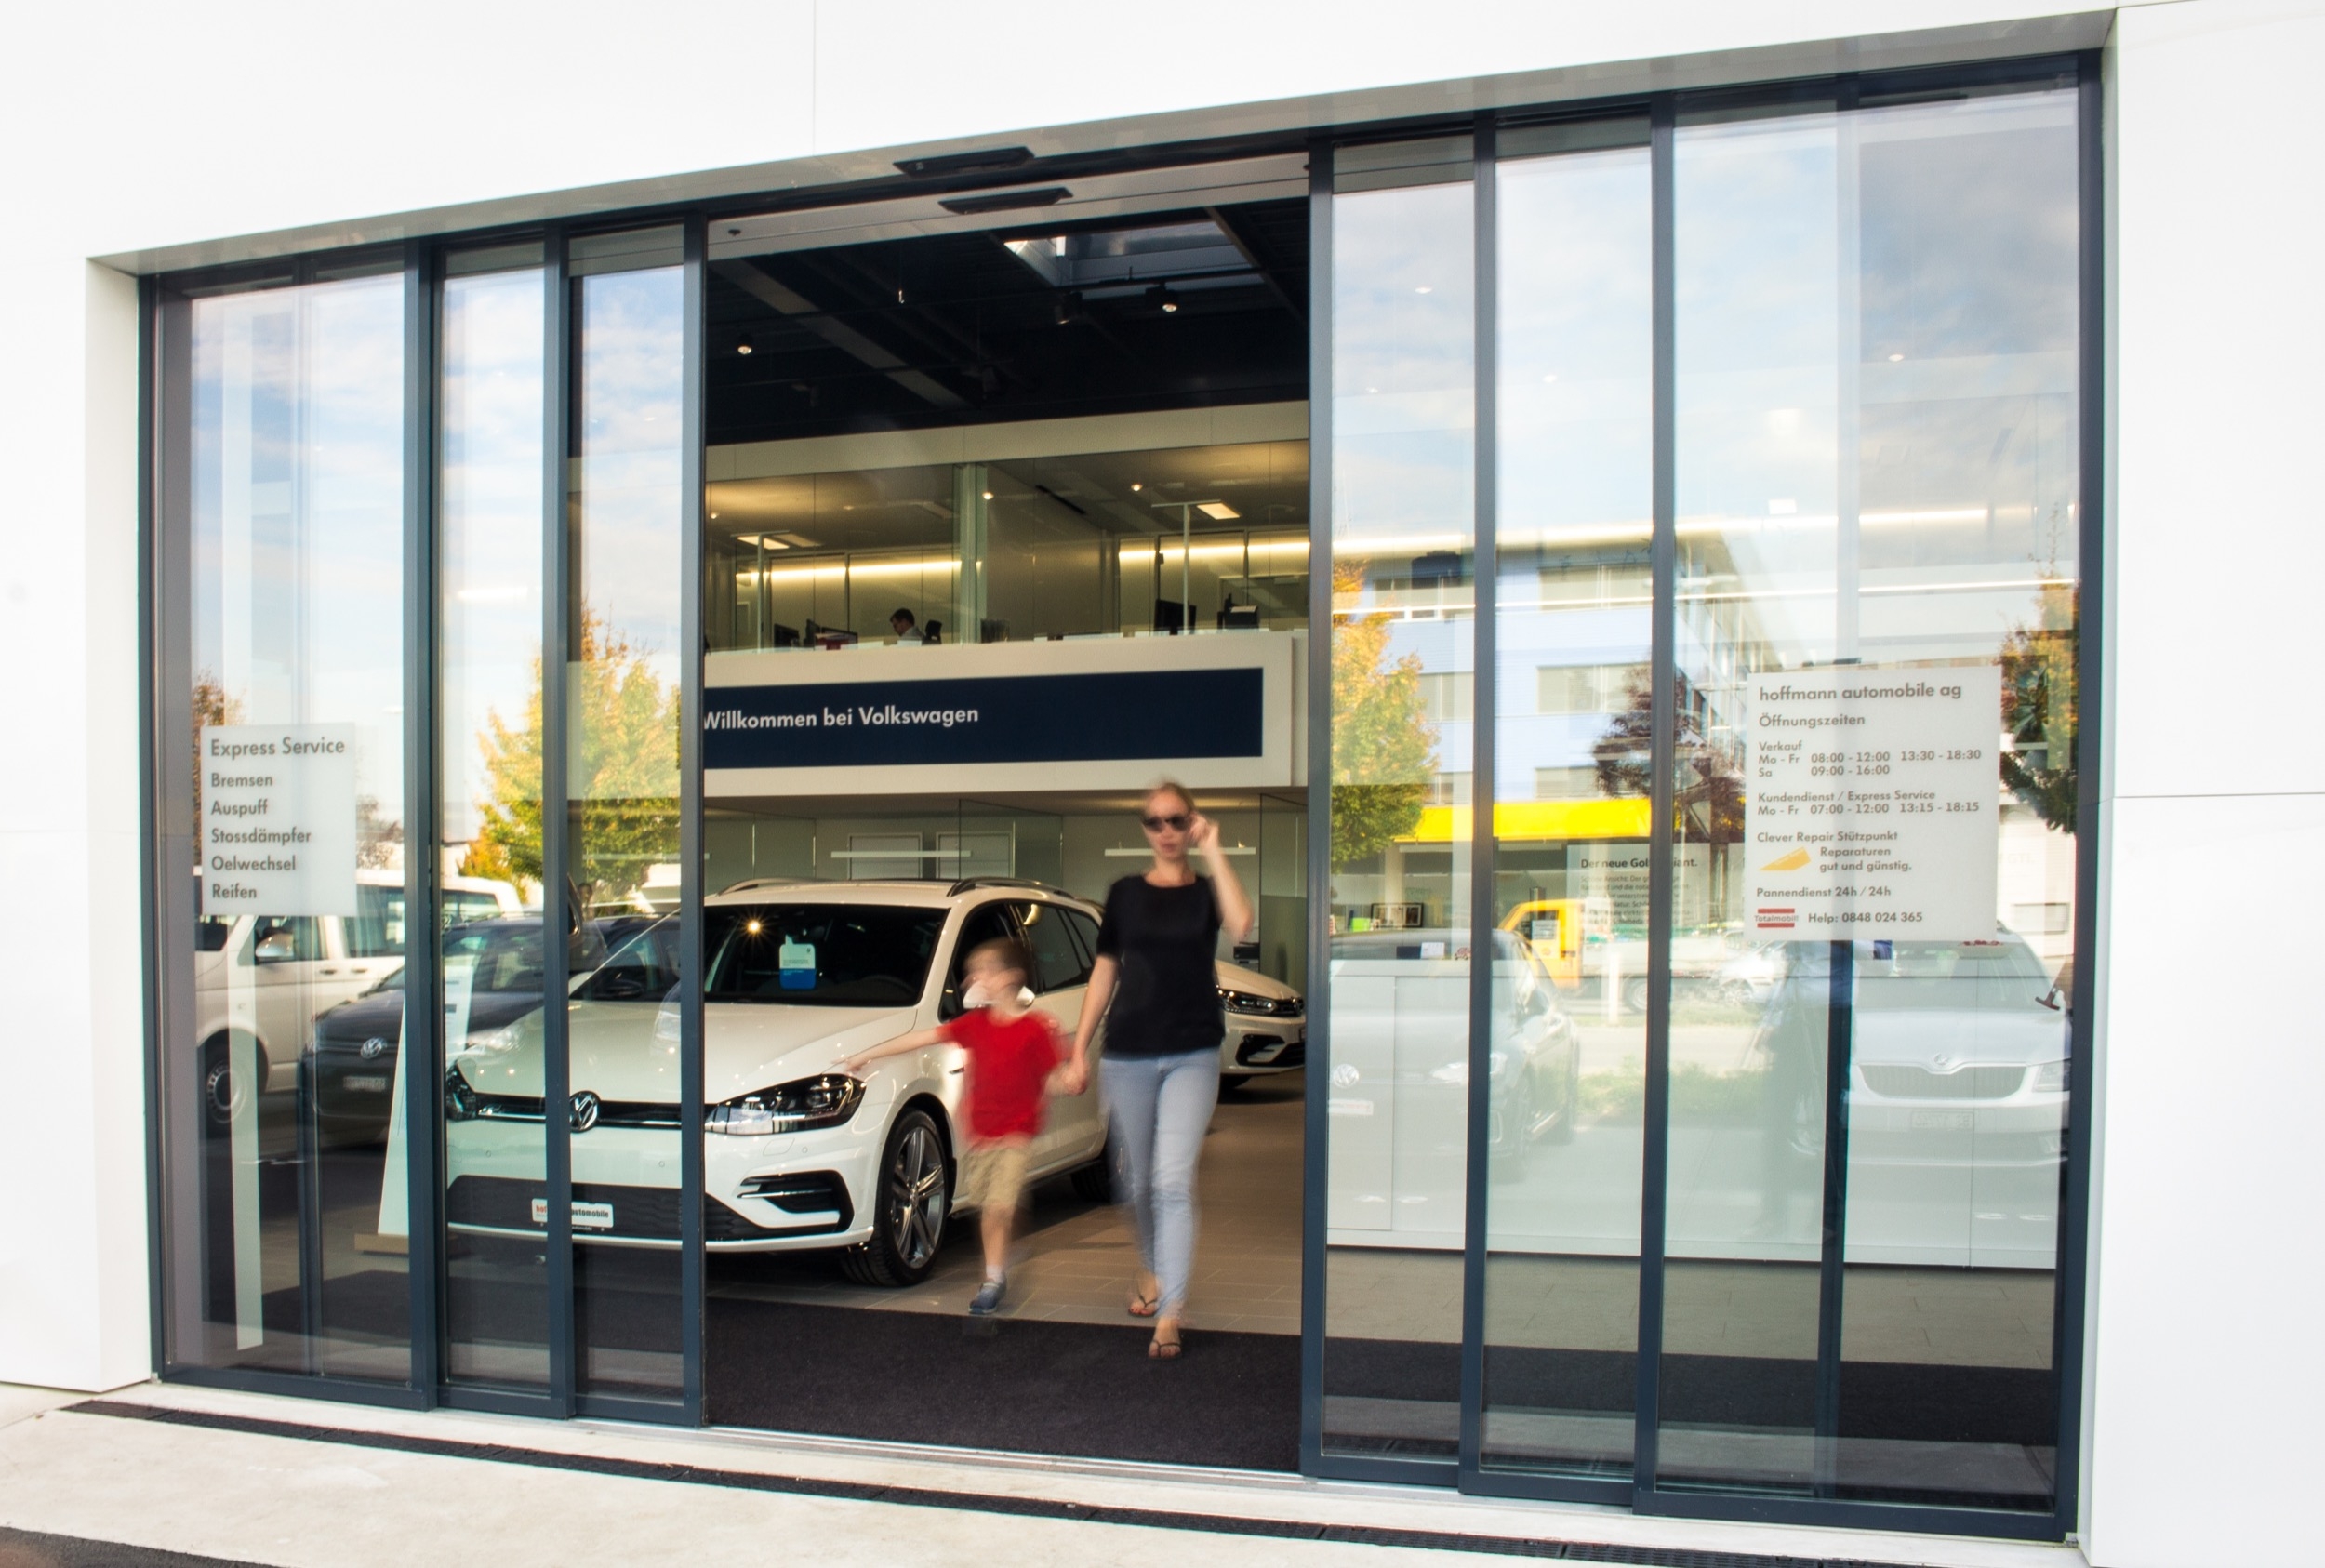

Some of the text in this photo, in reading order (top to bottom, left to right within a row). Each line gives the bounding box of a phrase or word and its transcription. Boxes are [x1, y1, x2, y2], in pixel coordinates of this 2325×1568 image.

[1760, 684, 1961, 701] hoffmann automobile ag
[704, 705, 979, 730] Willkommen bei Volkswagen
[1760, 712, 1865, 728] Öffnungszeiten
[211, 737, 345, 760] Express Service
[1760, 741, 1802, 751] Verkauf
[1759, 755, 1776, 764] Mo
[1789, 754, 1800, 764] Fr
[1811, 752, 1844, 763] 08:00
[1857, 751, 1890, 762] 12:00
[1901, 751, 1934, 761] 13:30
[1947, 750, 1981, 760] 18:30
[1759, 768, 1773, 777] Sa
[1811, 765, 1844, 776] 09:00
[1857, 764, 1890, 775] 16:00
[211, 773, 272, 787] Bremsen
[1759, 790, 1935, 802] Kundendienst / Express Service
[211, 799, 268, 817] Auspuff
[1759, 805, 1775, 815] Mo
[1787, 805, 1799, 815] Fr
[1811, 804, 1843, 814] 07:00
[1856, 804, 1889, 813] 12:00
[1900, 803, 1933, 813] 13:15
[1946, 802, 1979, 811] 18:15
[211, 827, 311, 845] Stossdämpfer
[1757, 831, 1897, 844] Clever Repair Stützpunkt
[1821, 846, 1891, 857] Reparaturen
[212, 856, 296, 871] Oelwechsel
[1581, 858, 1599, 868] Der
[1630, 857, 1649, 868] Gol
[1820, 860, 1912, 872] gut und günstig.
[212, 884, 257, 899] Reifen
[1757, 886, 1891, 897] Pannendienst 24h / 24h
[1809, 912, 1839, 924] Help:
[1841, 912, 1871, 923] 0848
[1875, 912, 1896, 923] 024
[1901, 912, 1923, 922] 365
